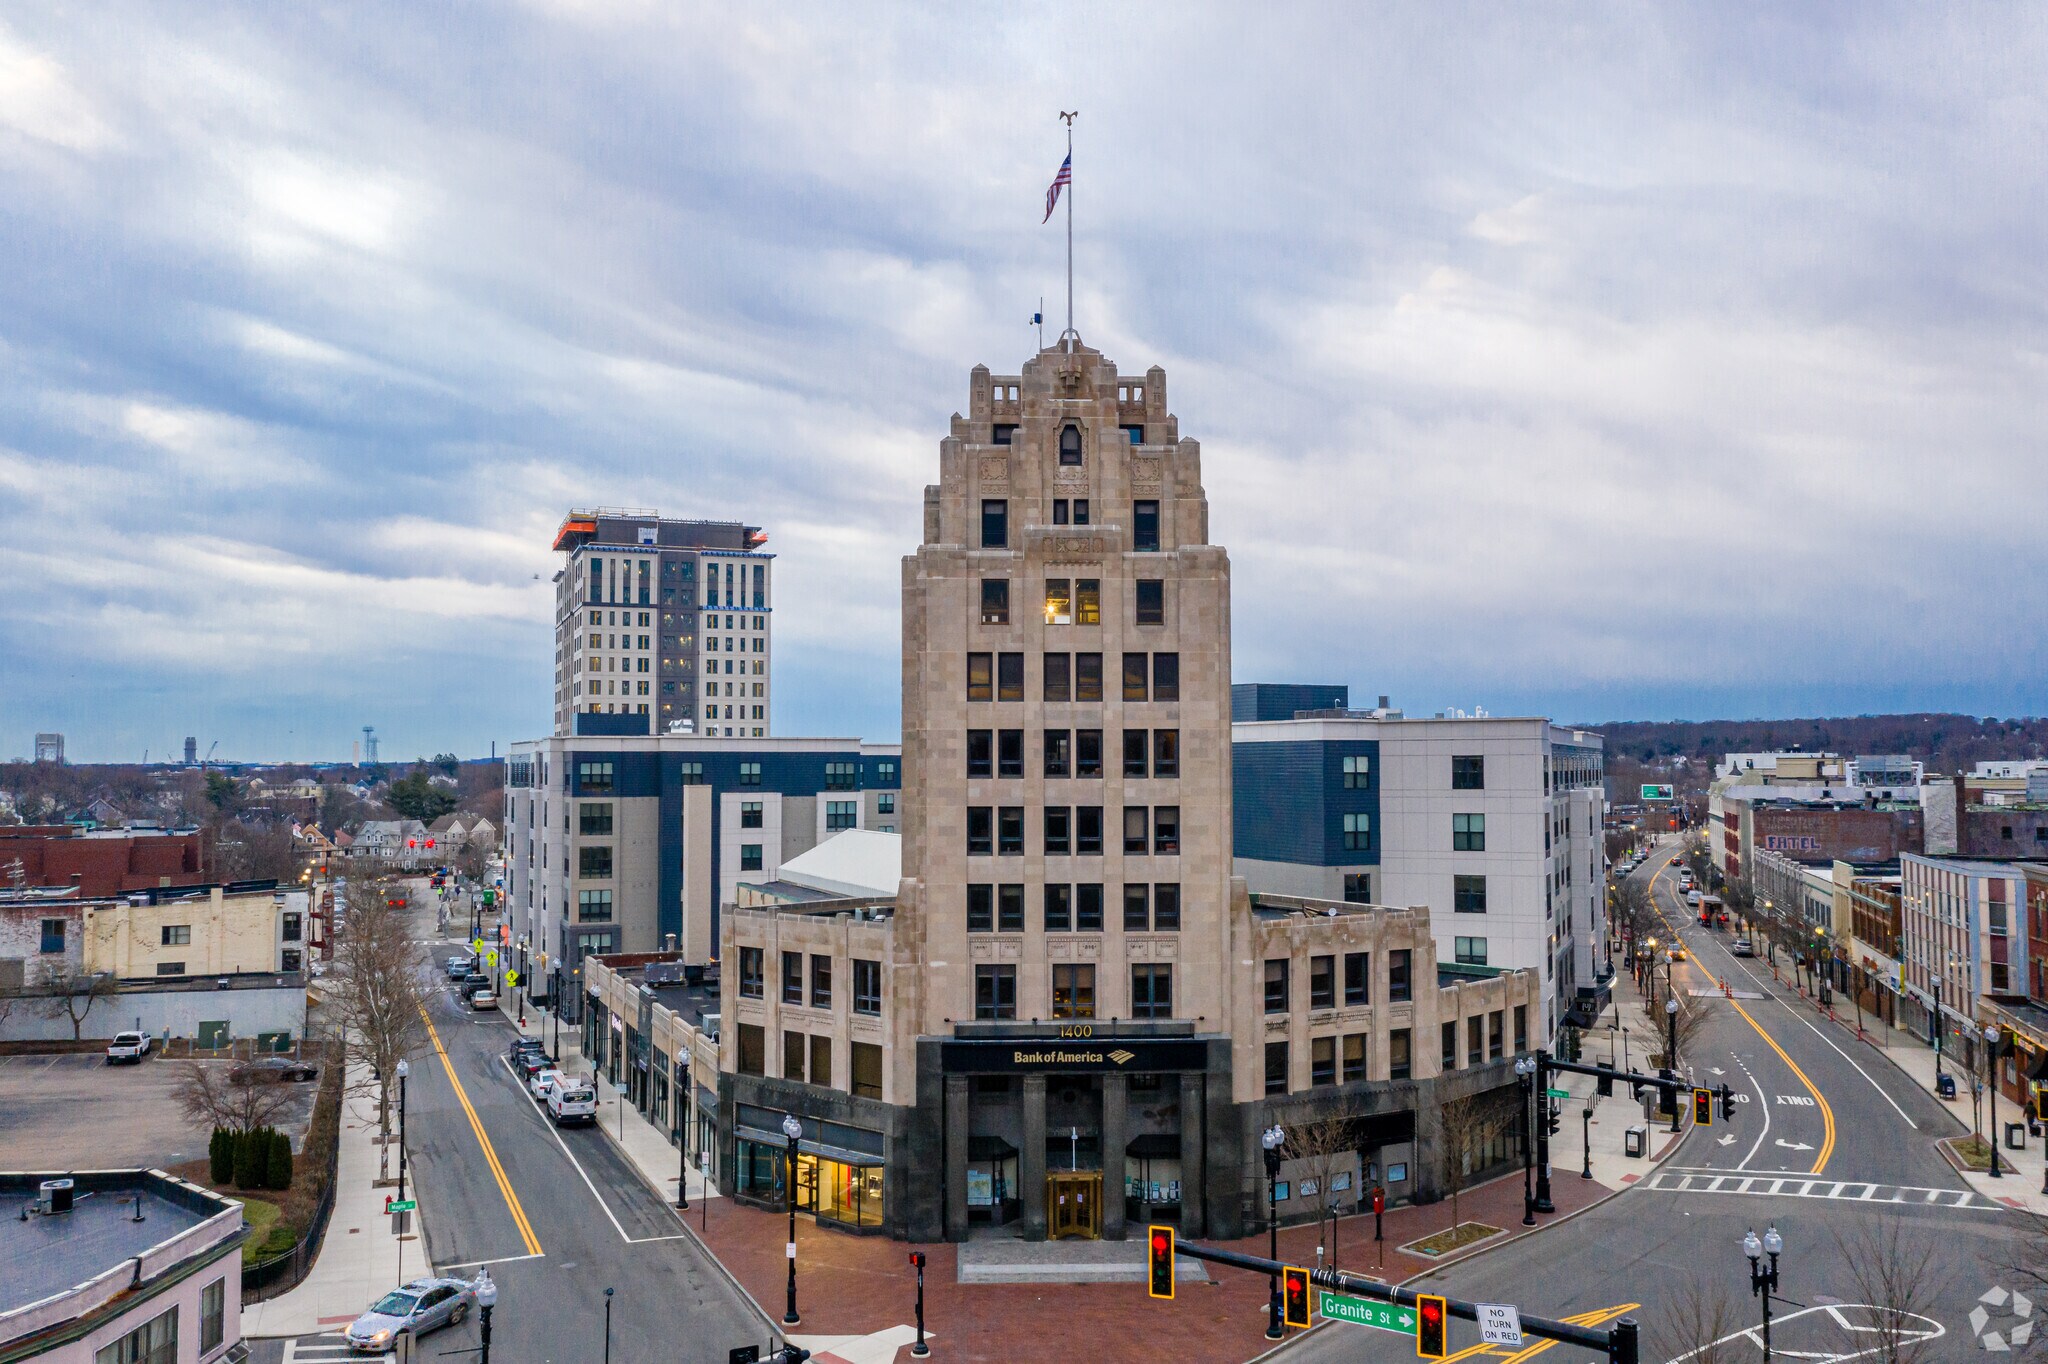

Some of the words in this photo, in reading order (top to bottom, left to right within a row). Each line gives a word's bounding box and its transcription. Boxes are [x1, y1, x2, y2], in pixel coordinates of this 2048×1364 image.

[1060, 1025, 1092, 1038] 1400
[1014, 1051, 1044, 1063] Bank
[1044, 1051, 1056, 1062] of
[1056, 1051, 1103, 1063] America
[1776, 1095, 1815, 1106] ONLY
[1325, 1298, 1373, 1320] Granite
[1380, 1311, 1390, 1324] St
[1489, 1309, 1504, 1317] NO
[1487, 1319, 1512, 1329] TURN
[1484, 1330, 1497, 1339] ON
[1501, 1331, 1518, 1341] RED
